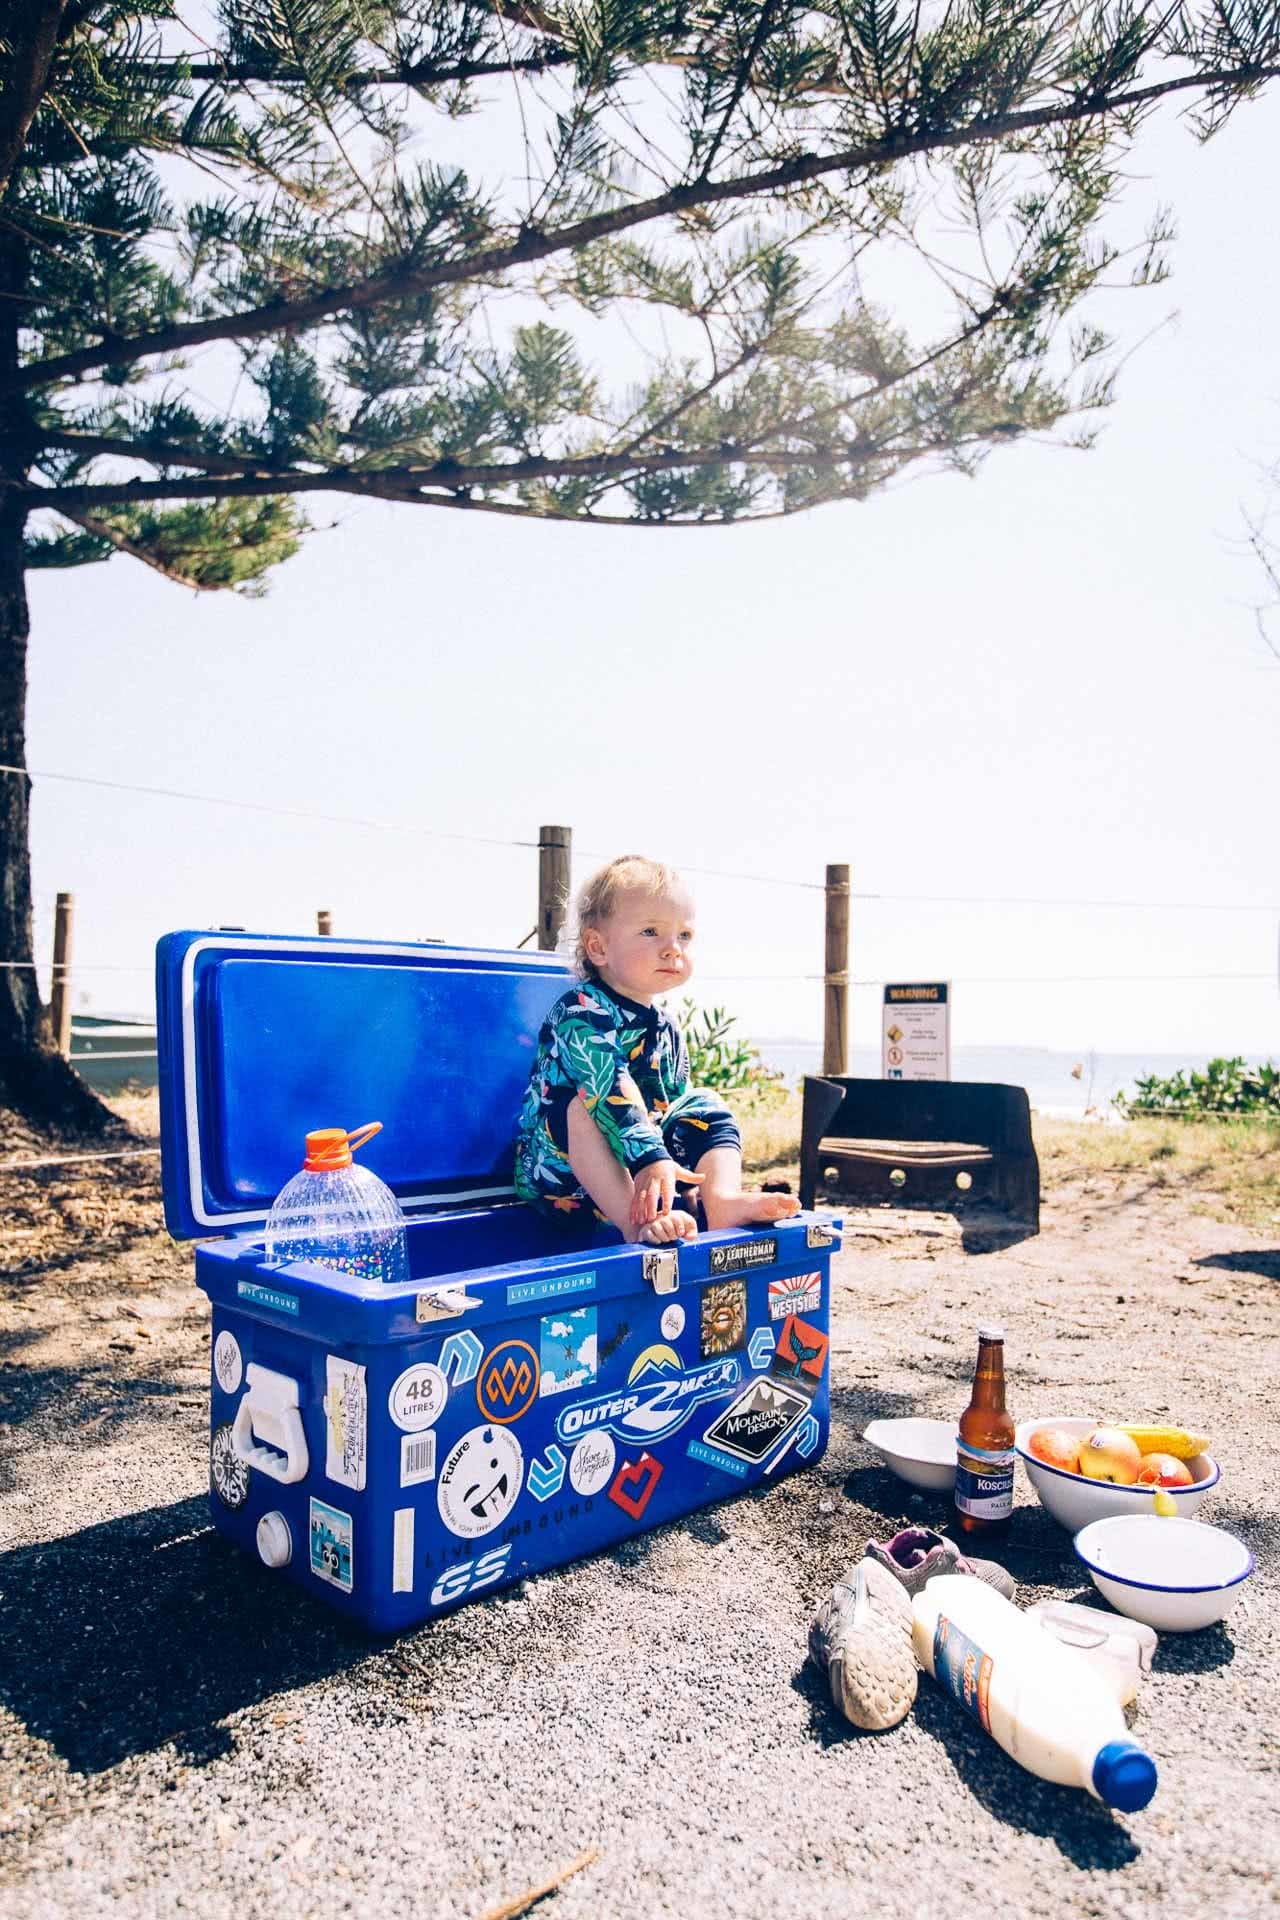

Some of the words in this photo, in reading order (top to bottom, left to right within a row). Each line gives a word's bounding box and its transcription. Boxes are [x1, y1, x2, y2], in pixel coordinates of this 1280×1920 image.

[890, 988, 938, 999] WARNING
[727, 1243, 775, 1261] LEATHERMAN
[512, 1287, 535, 1299] LIVE
[542, 1277, 592, 1293] UNBOUND
[260, 1292, 297, 1310] UNBOUND
[406, 1379, 433, 1400] 48
[403, 1401, 434, 1416] LITRES
[726, 1407, 781, 1436] MOUNTAIN
[747, 1411, 788, 1435] DESIGNS
[690, 1445, 707, 1457] LIVE
[441, 1441, 471, 1485] Future
[977, 1479, 1013, 1491] KOSCIUS
